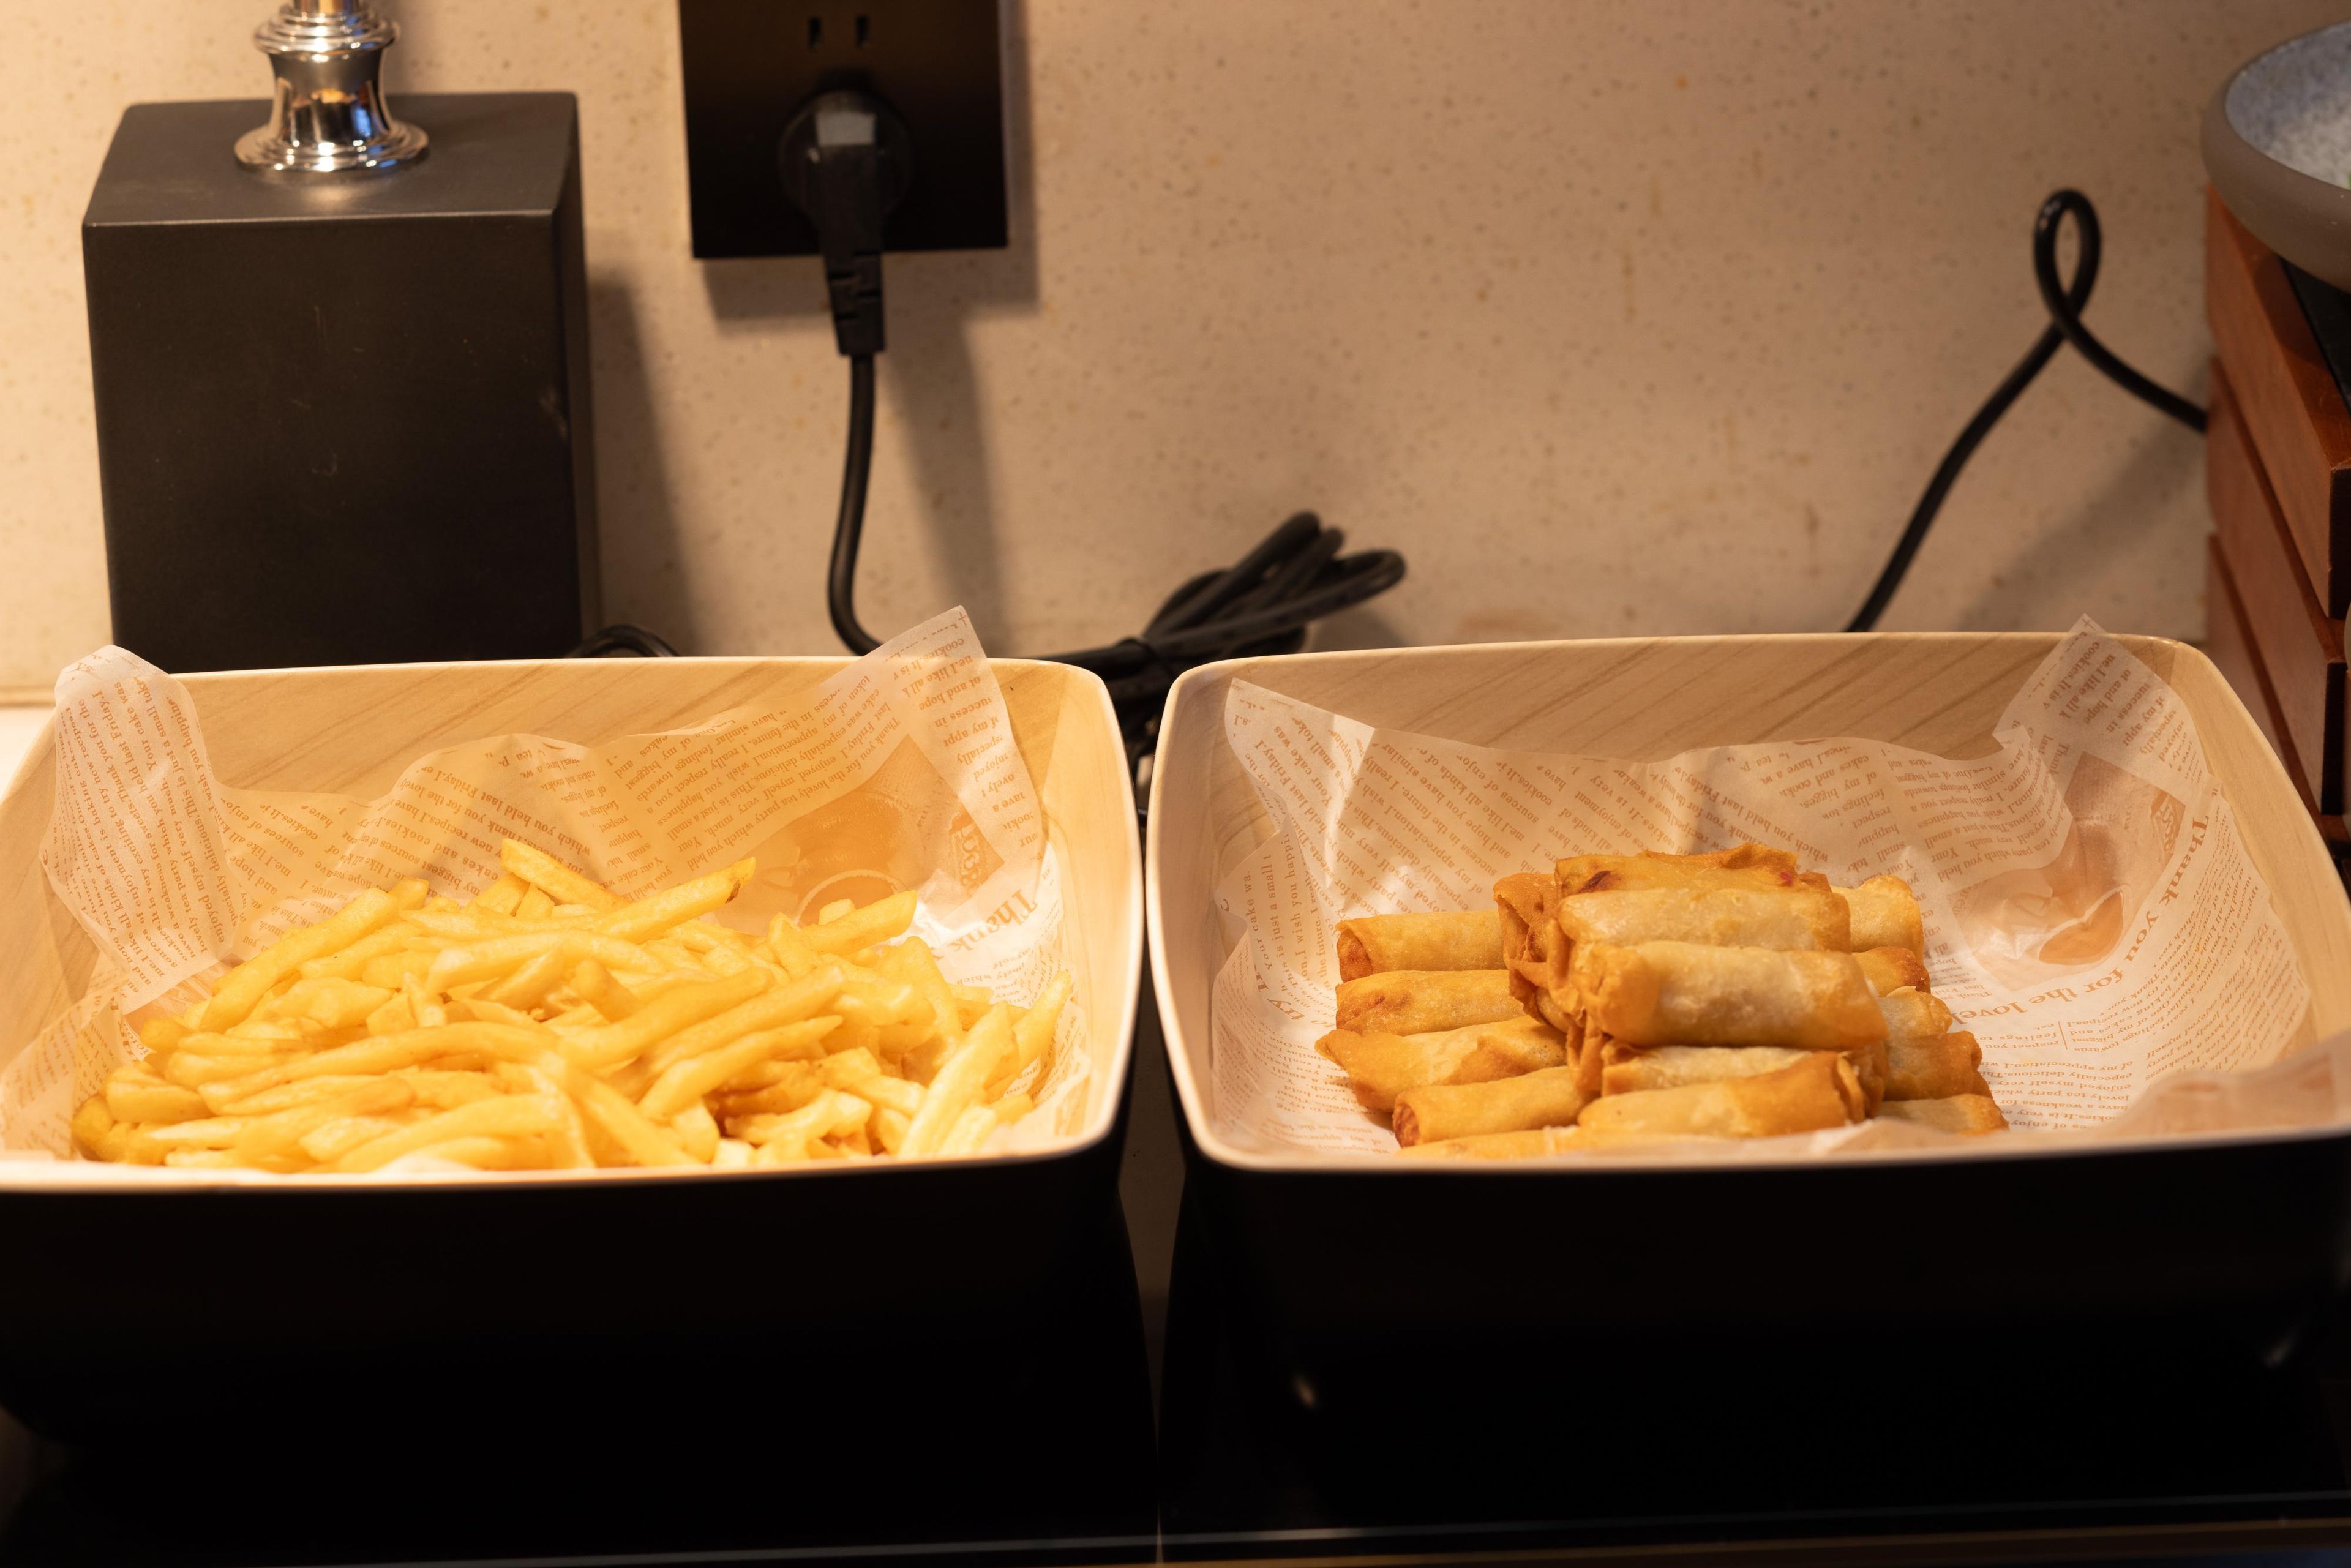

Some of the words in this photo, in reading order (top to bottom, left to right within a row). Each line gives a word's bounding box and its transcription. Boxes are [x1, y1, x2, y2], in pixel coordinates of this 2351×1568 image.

[848, 675, 871, 703] token
[861, 689, 880, 713] cake
[946, 680, 967, 699] and
[2104, 680, 2121, 699] and
[873, 702, 891, 720] last
[919, 693, 943, 711] hope
[2066, 695, 2079, 710] all
[2083, 700, 2104, 724] hope
[127, 707, 144, 735] cake
[147, 706, 166, 737] small
[752, 713, 775, 728] have
[875, 716, 900, 745] Thank
[714, 724, 749, 749] similar
[748, 727, 782, 746] future.
[800, 727, 846, 760] especially
[119, 742, 133, 764] last
[143, 739, 157, 771] Your
[167, 750, 183, 772] just
[710, 749, 738, 772] really
[1291, 749, 1311, 775] cake
[1311, 742, 1335, 770] small
[1382, 745, 1419, 777] similar
[624, 759, 662, 791] biggest
[726, 763, 749, 782] wish
[798, 756, 836, 781] enjoyed
[1364, 757, 1392, 783] really
[1787, 759, 1813, 774] have
[130, 766, 149, 793] held
[199, 773, 212, 800] wish
[636, 772, 673, 803] towards
[674, 768, 708, 793] respect
[762, 776, 795, 800] myself
[798, 780, 828, 798] lovely
[1420, 778, 1445, 803] have
[1441, 767, 1467, 795] kinds
[1544, 768, 1566, 790] have
[1590, 776, 1613, 797] very
[1973, 771, 2006, 790] similar
[80, 781, 102, 825] baking
[162, 778, 176, 815] much.
[480, 793, 503, 811] last
[1291, 784, 1309, 806] last
[1310, 777, 1332, 807] Your
[1361, 784, 1385, 808] wish
[1401, 787, 1431, 819] future.
[1842, 789, 1885, 811] feelings
[1903, 786, 1937, 797] towards
[1969, 795, 1993, 807] really
[309, 808, 333, 828] have
[394, 799, 419, 819] have
[504, 805, 531, 827] held
[656, 793, 702, 827] happiness
[701, 801, 718, 817] just
[738, 797, 759, 815] very
[754, 801, 780, 823] party
[1483, 806, 1502, 827] like
[1500, 792, 1539, 823] sources
[1574, 791, 1621, 830] enjoyment
[1721, 797, 1744, 816] last
[598, 815, 629, 833] respect
[667, 819, 692, 840] small
[705, 816, 733, 836] much.
[1572, 817, 1598, 842] kinds
[1745, 811, 1771, 833] held
[1852, 807, 1891, 830] respect
[1917, 808, 1964, 829] happiness
[2018, 818, 2046, 842] myself
[118, 819, 143, 864] exciting
[159, 819, 173, 855] which
[230, 831, 245, 846] all
[263, 828, 304, 859] sources
[471, 837, 492, 853] new
[558, 833, 591, 856] which
[677, 836, 702, 852] Your
[724, 823, 754, 846] which
[1466, 821, 1490, 847] hope
[1548, 826, 1571, 848] have
[1924, 830, 1952, 849] small
[1965, 836, 1992, 848] much.
[246, 841, 266, 860] like
[380, 840, 421, 866] sources
[686, 852, 705, 870] held
[1355, 838, 1378, 861] very
[1461, 845, 1497, 877] success
[1491, 843, 1511, 860] and
[1795, 840, 1828, 862] which
[1877, 841, 1905, 861] small
[1930, 847, 1959, 863] Your
[2159, 816, 2209, 907] Thank
[106, 844, 141, 907] enjoyment
[170, 860, 186, 890] party
[182, 850, 206, 891] myself
[230, 855, 255, 879] hope
[421, 861, 461, 890] biggest
[462, 857, 498, 882] cakes
[1377, 859, 1415, 890] myself
[1937, 865, 1962, 882] held
[156, 863, 176, 919] weakness
[255, 876, 277, 896] and
[1261, 865, 1275, 898] small
[1421, 865, 1469, 911] especially
[1289, 884, 1302, 907] you
[200, 895, 225, 943] enjoyed
[948, 890, 1038, 955] Thank
[1245, 899, 1259, 931] cake
[189, 917, 208, 953] lovely
[1270, 915, 1284, 940] just
[1291, 913, 1303, 943] wish
[1314, 917, 1326, 955] future.
[2124, 911, 2159, 961] you
[141, 929, 177, 968] sources
[1256, 938, 1273, 971] Your
[1316, 959, 1327, 978] the
[2083, 968, 2124, 996] for
[2029, 988, 2079, 1003] the
[1952, 1001, 2027, 1024] lovel
[2069, 1072, 2132, 1081] especially
[2023, 1100, 2082, 1109] weakness
